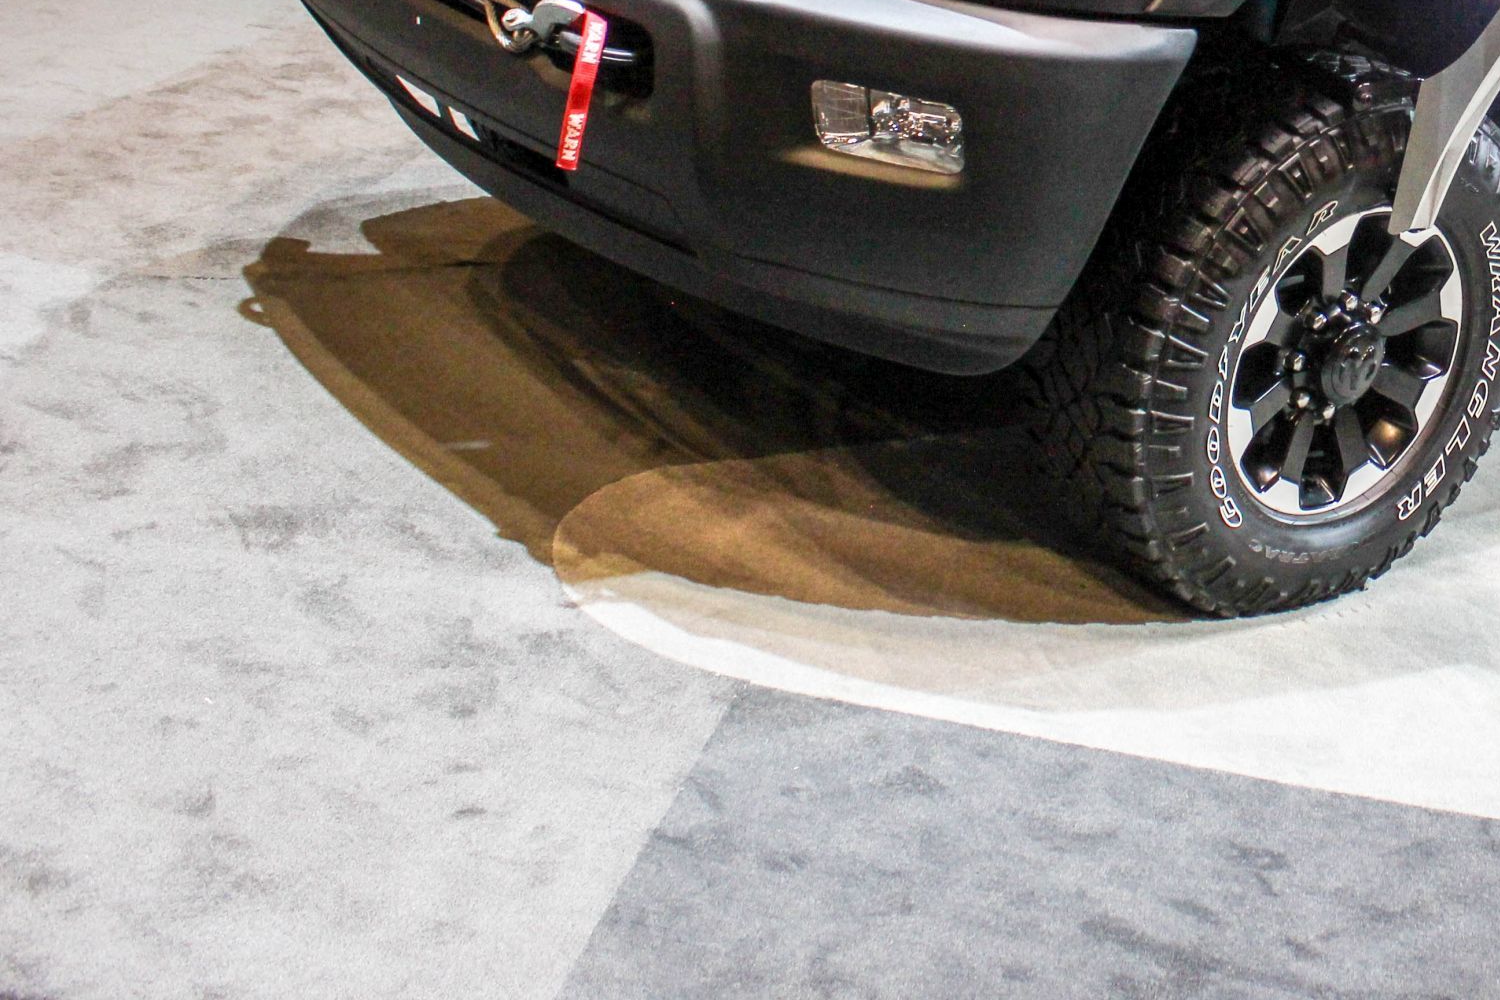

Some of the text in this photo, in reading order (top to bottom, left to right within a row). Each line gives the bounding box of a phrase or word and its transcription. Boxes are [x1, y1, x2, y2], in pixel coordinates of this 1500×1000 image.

[580, 20, 606, 64] WARN
[561, 112, 585, 161] WARN
[1207, 201, 1338, 528] GOODYEAR
